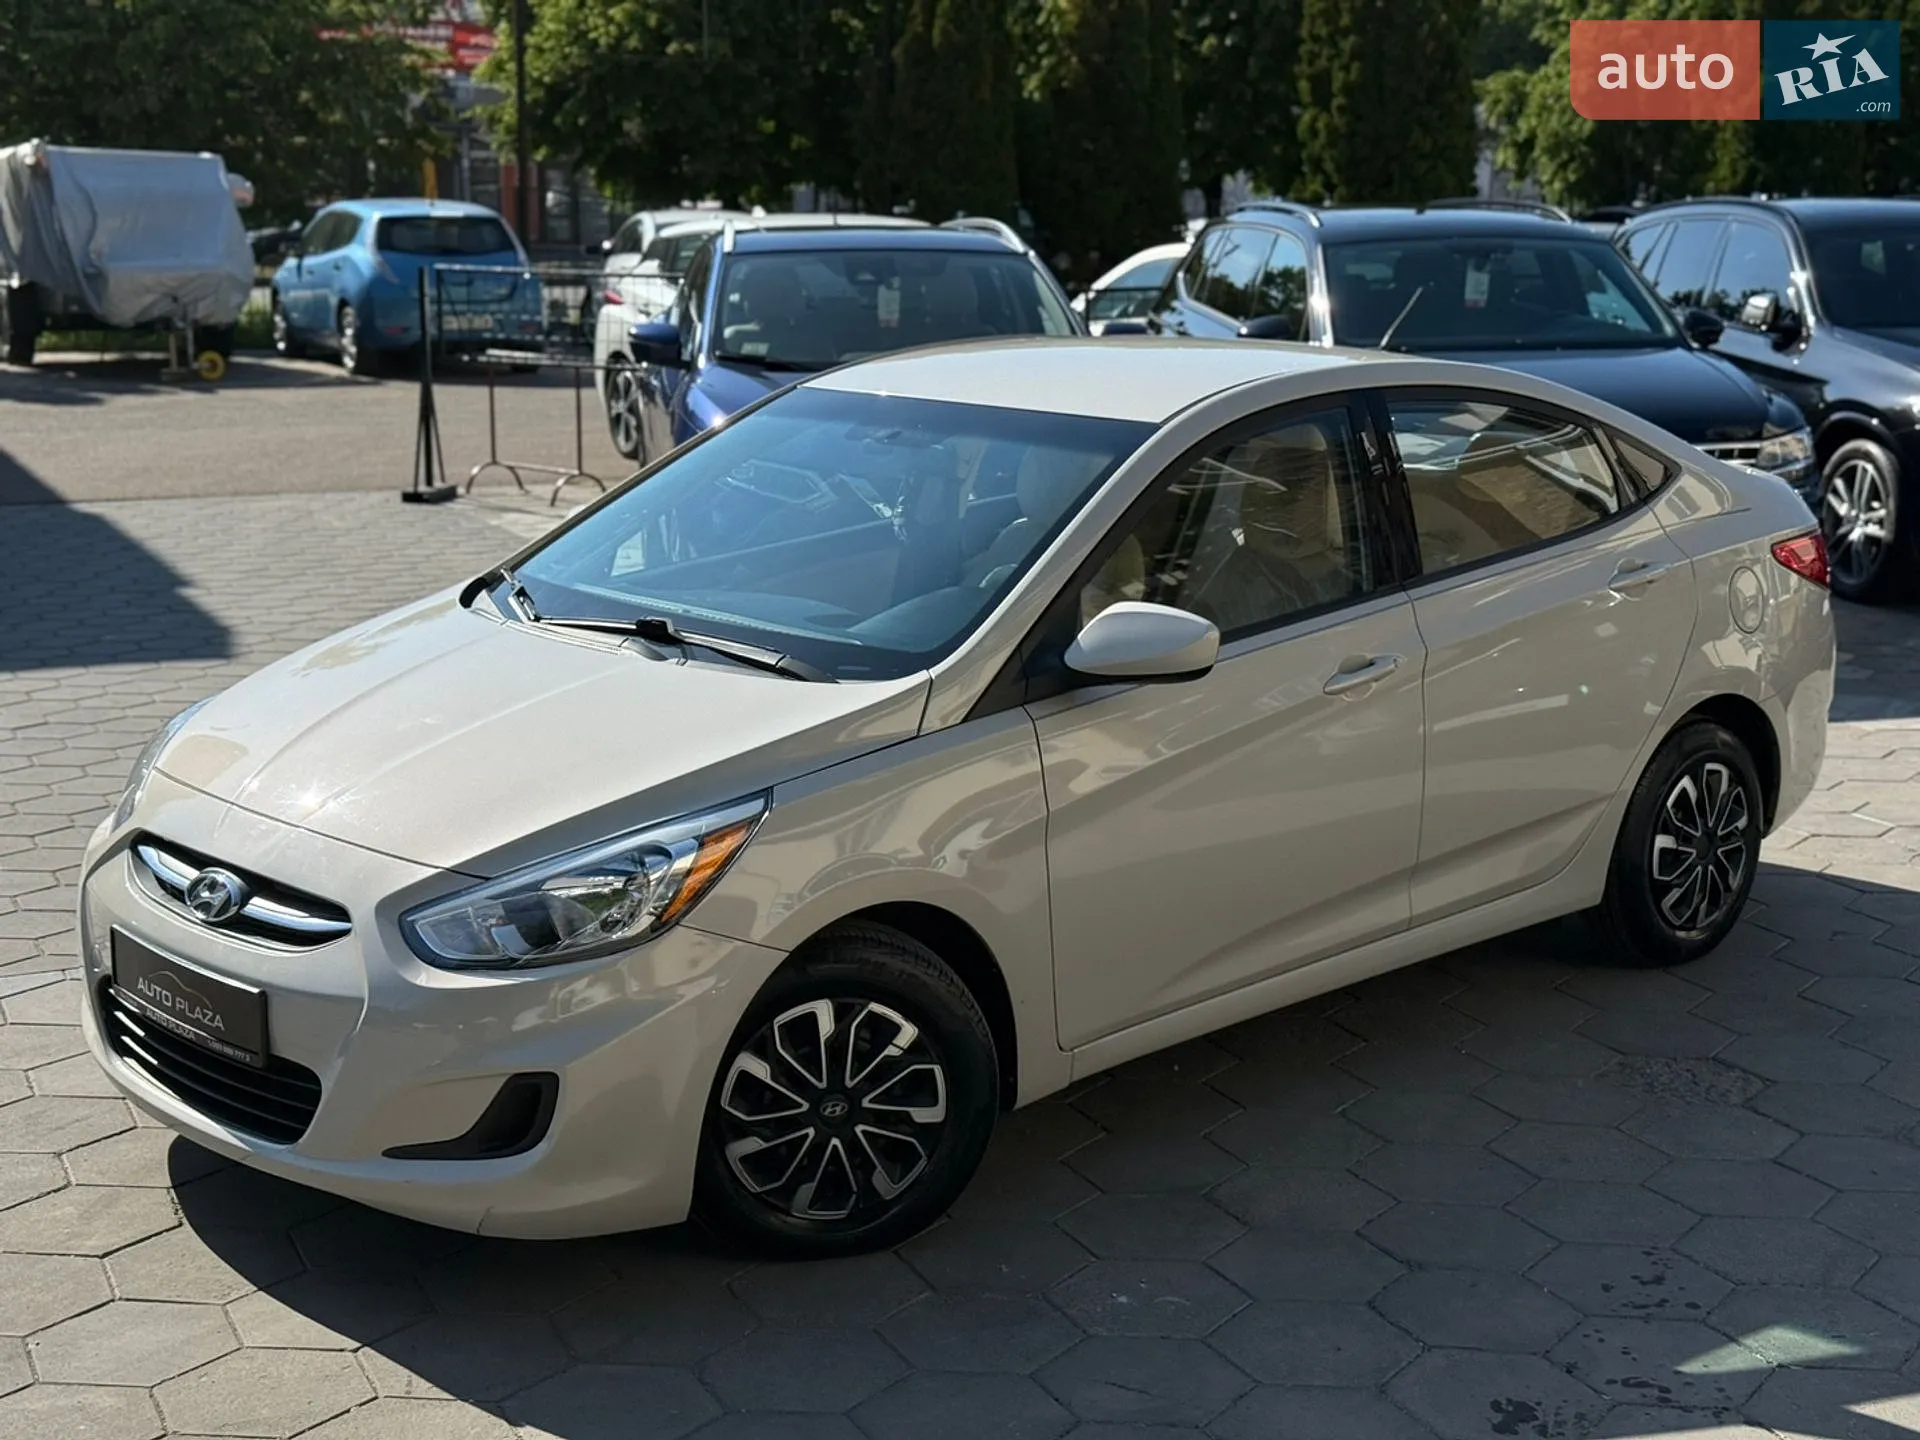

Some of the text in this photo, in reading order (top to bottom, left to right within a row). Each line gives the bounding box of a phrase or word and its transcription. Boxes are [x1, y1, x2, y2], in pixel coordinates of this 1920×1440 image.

[137, 977, 172, 1006] AUTO
[175, 996, 225, 1031] PLAZA
[167, 1019, 196, 1041] PLAZA
